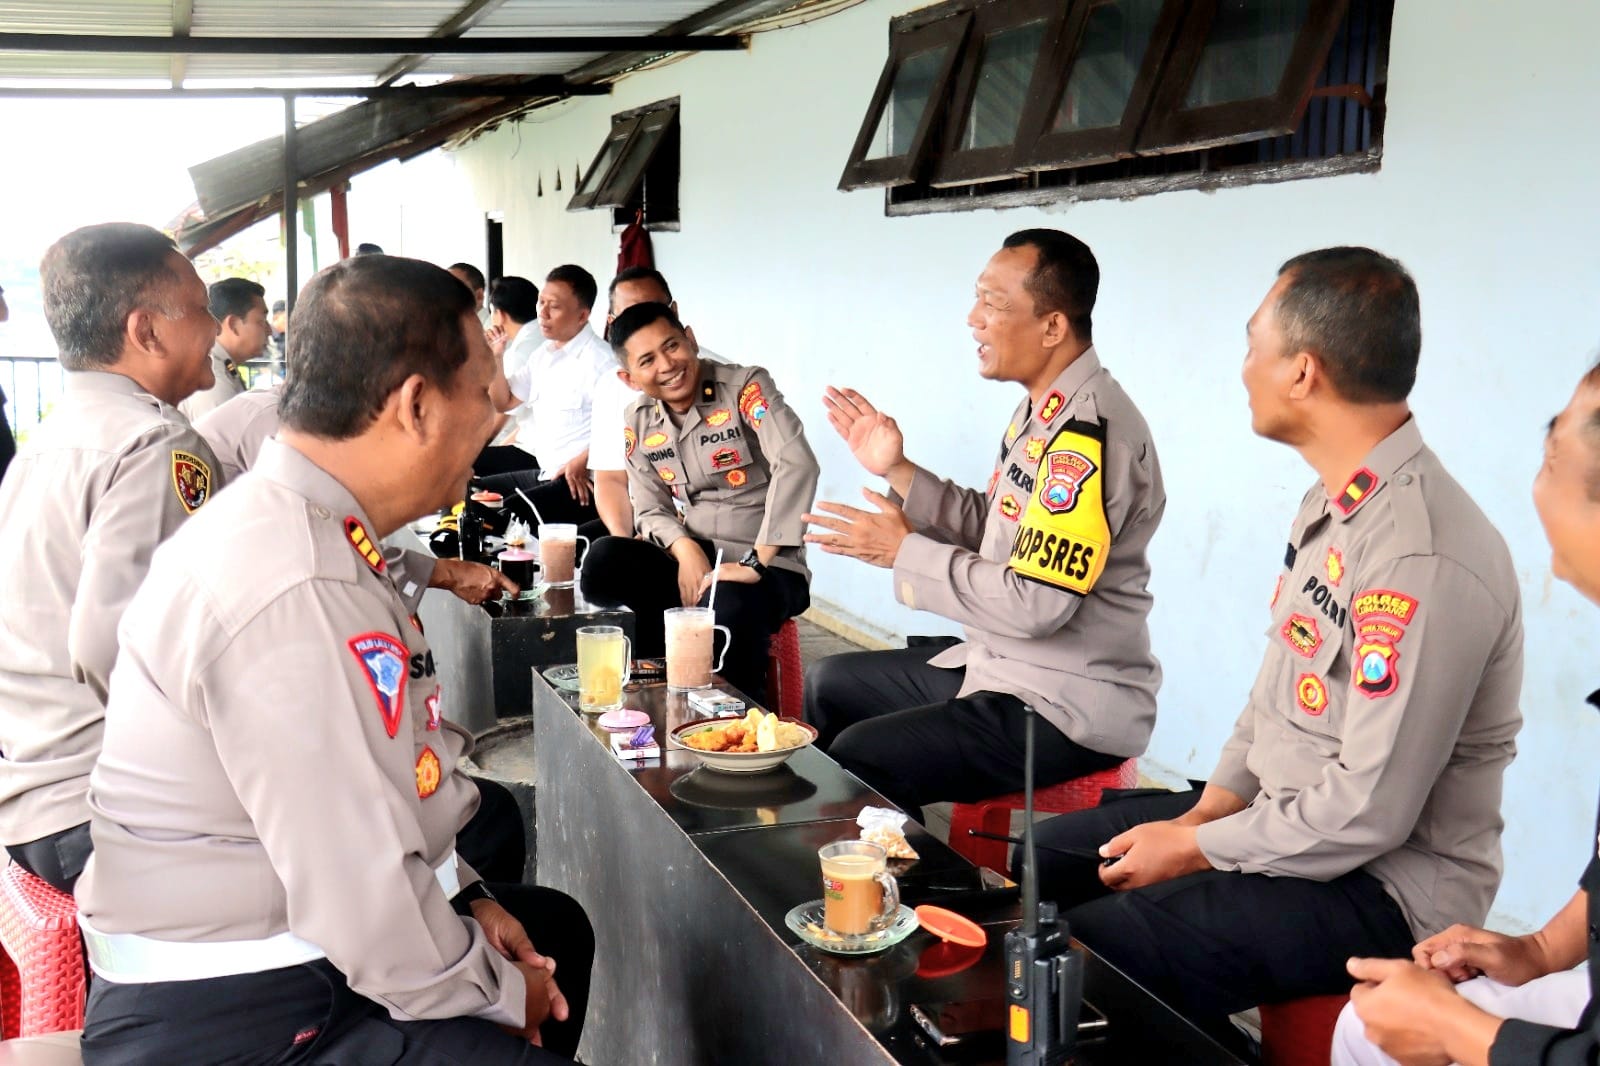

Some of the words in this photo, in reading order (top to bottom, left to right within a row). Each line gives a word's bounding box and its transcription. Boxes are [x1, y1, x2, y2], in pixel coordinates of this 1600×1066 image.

[700, 427, 741, 446] POLRI
[1006, 462, 1034, 494] POLRI
[1010, 524, 1095, 581] AOPSRES
[1302, 575, 1347, 629] POLRI
[1355, 593, 1411, 611] POLRES
